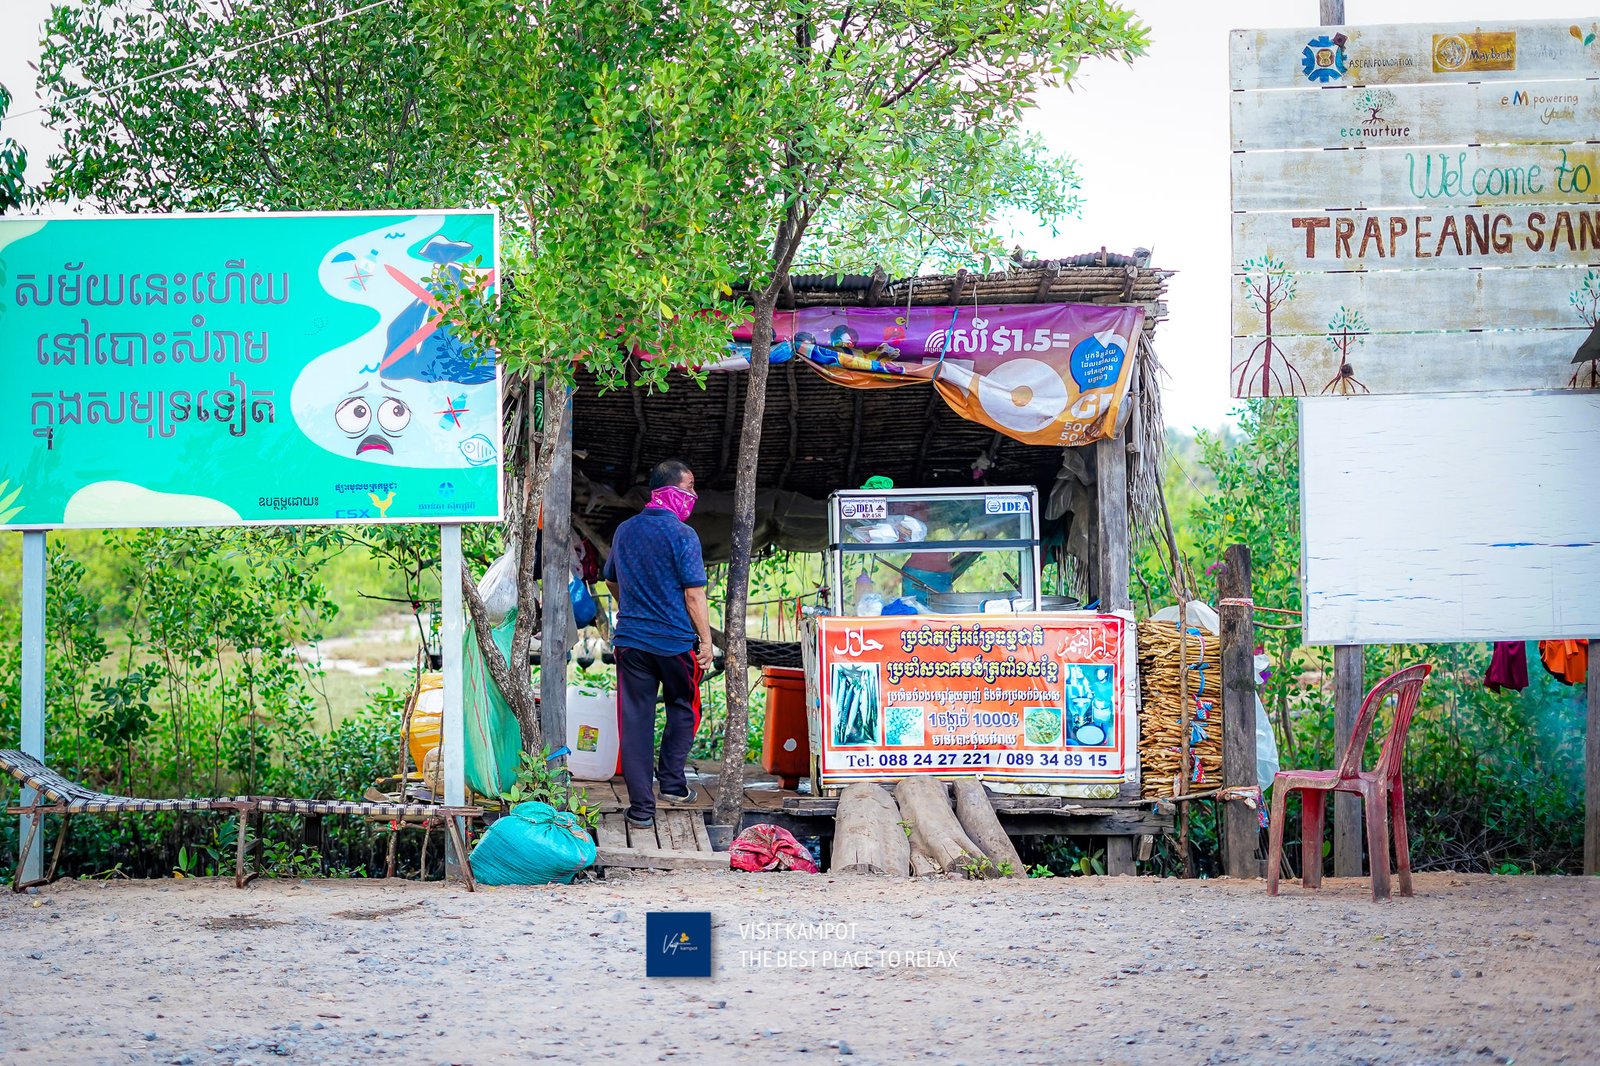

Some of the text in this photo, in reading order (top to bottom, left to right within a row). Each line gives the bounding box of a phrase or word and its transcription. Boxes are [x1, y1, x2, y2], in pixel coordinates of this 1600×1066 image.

[1340, 125, 1410, 138] econurture
[1405, 149, 1592, 199] Welcome to
[1292, 213, 1513, 258] TRAPEANG
[15, 259, 289, 306] សម័យនេះហើយ
[37, 314, 268, 366] នៅបោះសំរាម
[31, 372, 274, 450] ក្នុងសមុទ្រទៀត
[857, 504, 873, 512] IDEA
[1002, 502, 1030, 511] IDEA
[834, 626, 884, 657] حلال
[846, 753, 1107, 767] Tel: 088 24 27 221 / 089 34 89 15
